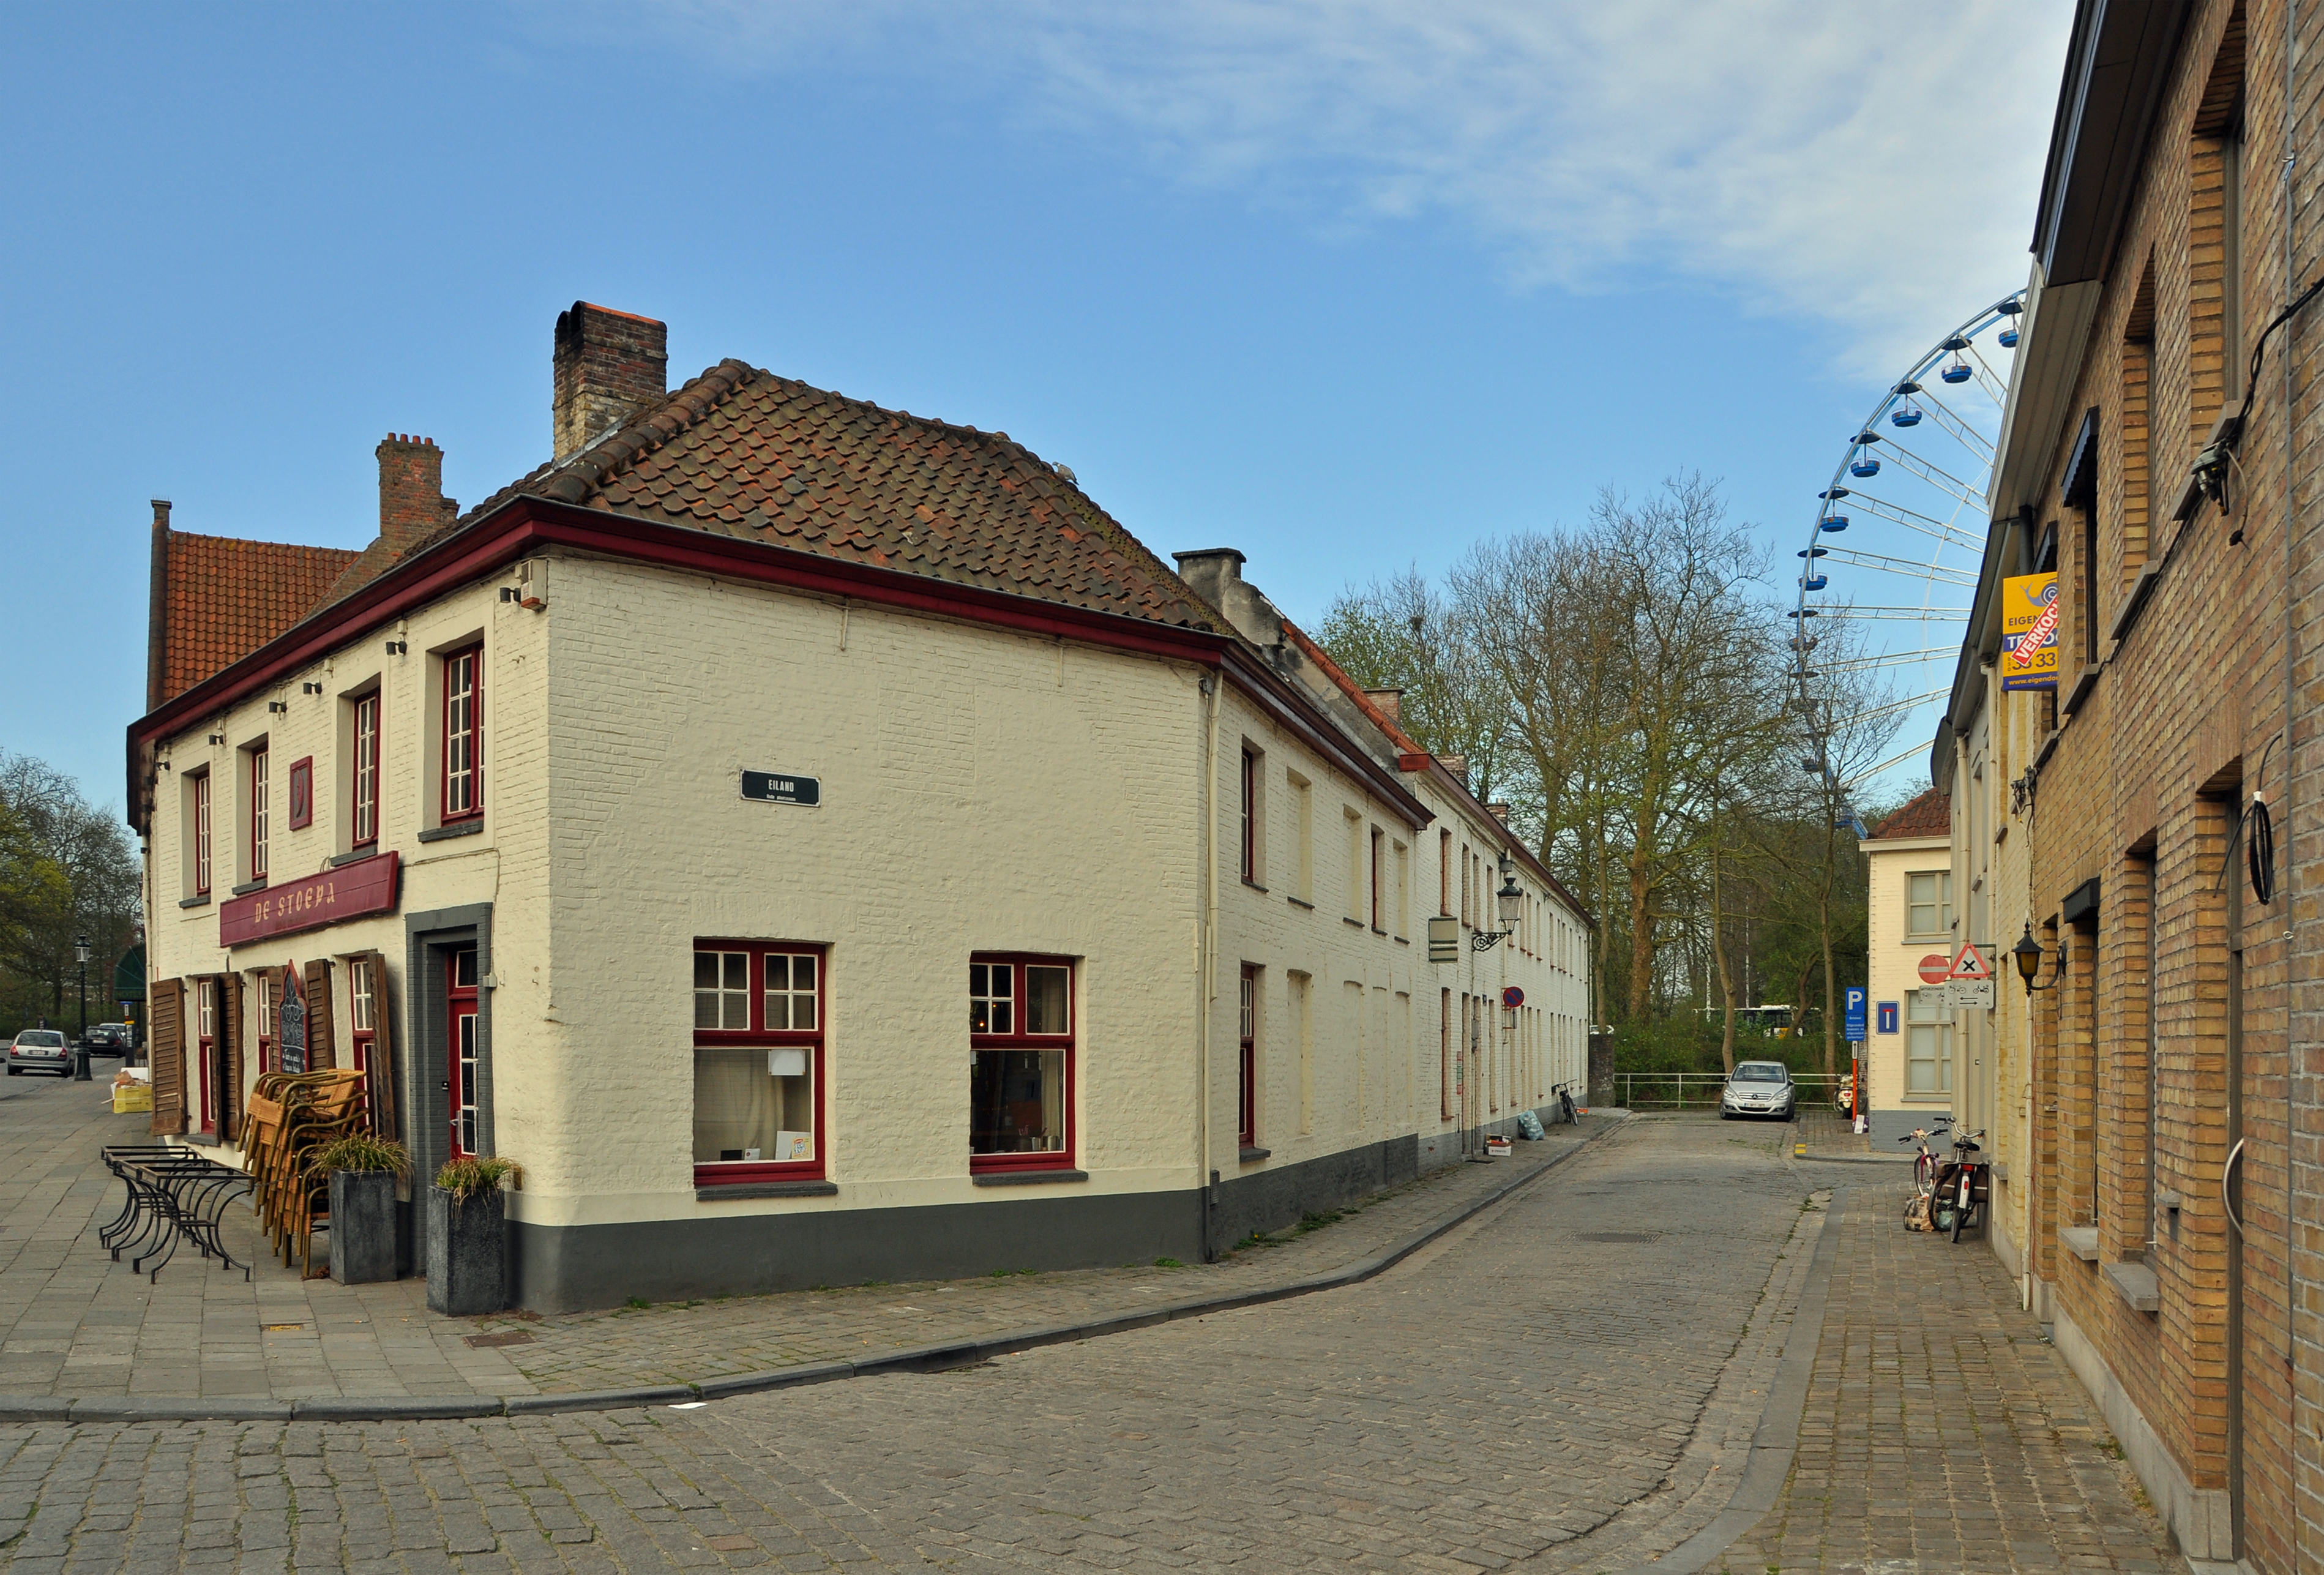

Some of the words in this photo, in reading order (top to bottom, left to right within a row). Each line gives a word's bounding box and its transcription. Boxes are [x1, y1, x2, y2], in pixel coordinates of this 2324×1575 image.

[2016, 599, 2058, 658] VERKOC
[2036, 652, 2056, 668] 33
[768, 779, 794, 792] EILAND
[255, 900, 271, 923] DE
[1848, 991, 1863, 1010] P
